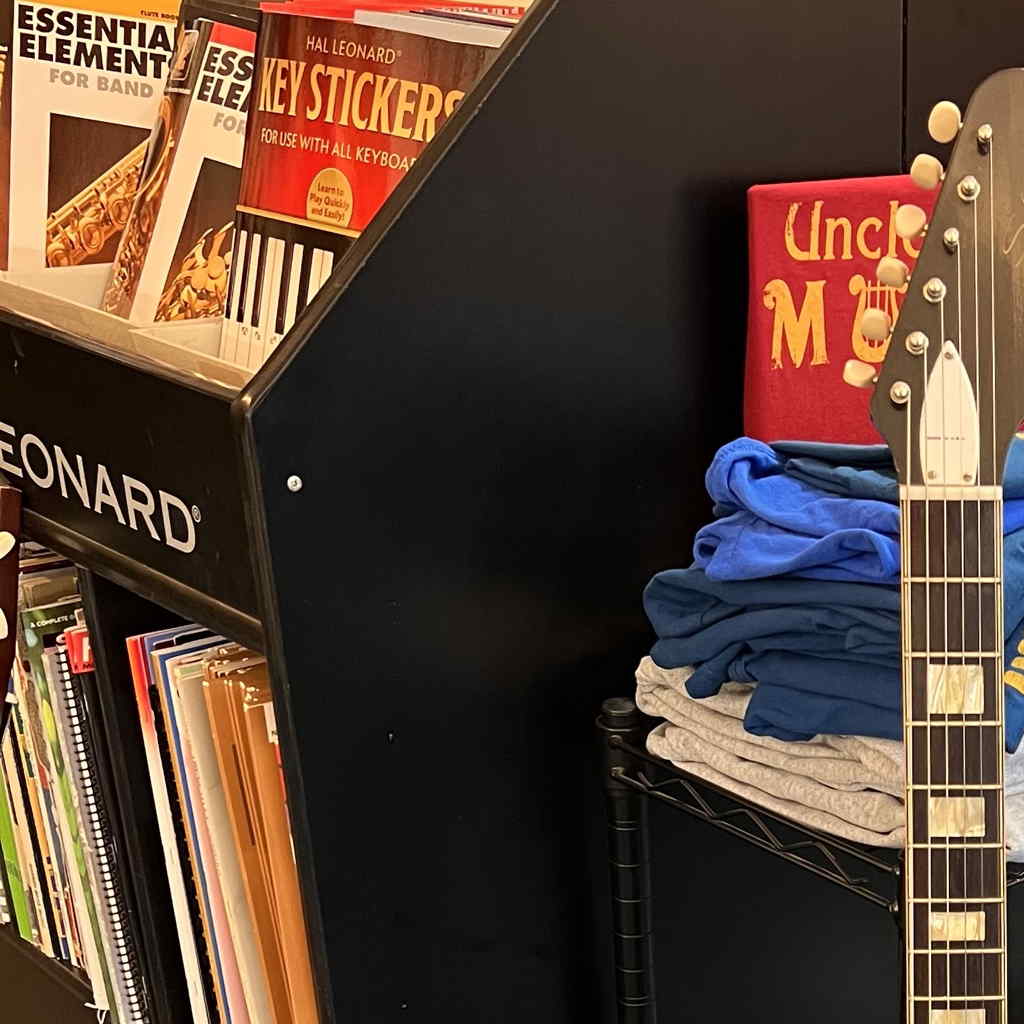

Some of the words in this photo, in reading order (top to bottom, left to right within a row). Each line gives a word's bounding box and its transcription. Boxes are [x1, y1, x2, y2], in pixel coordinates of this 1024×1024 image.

[18, 5, 177, 52] ESSENTIA
[19, 33, 172, 79] ELEMENT
[306, 36, 329, 54] HAL
[49, 68, 89, 89] FOR
[97, 78, 153, 99] BAND
[258, 57, 305, 117] KEY
[261, 128, 278, 145] FOR
[279, 132, 297, 149] USE
[299, 134, 329, 154] WITH
[331, 142, 352, 160] ALL
[310, 192, 322, 206] Play
[323, 195, 350, 211] Quickly
[36, 614, 69, 628] COMPLETE
